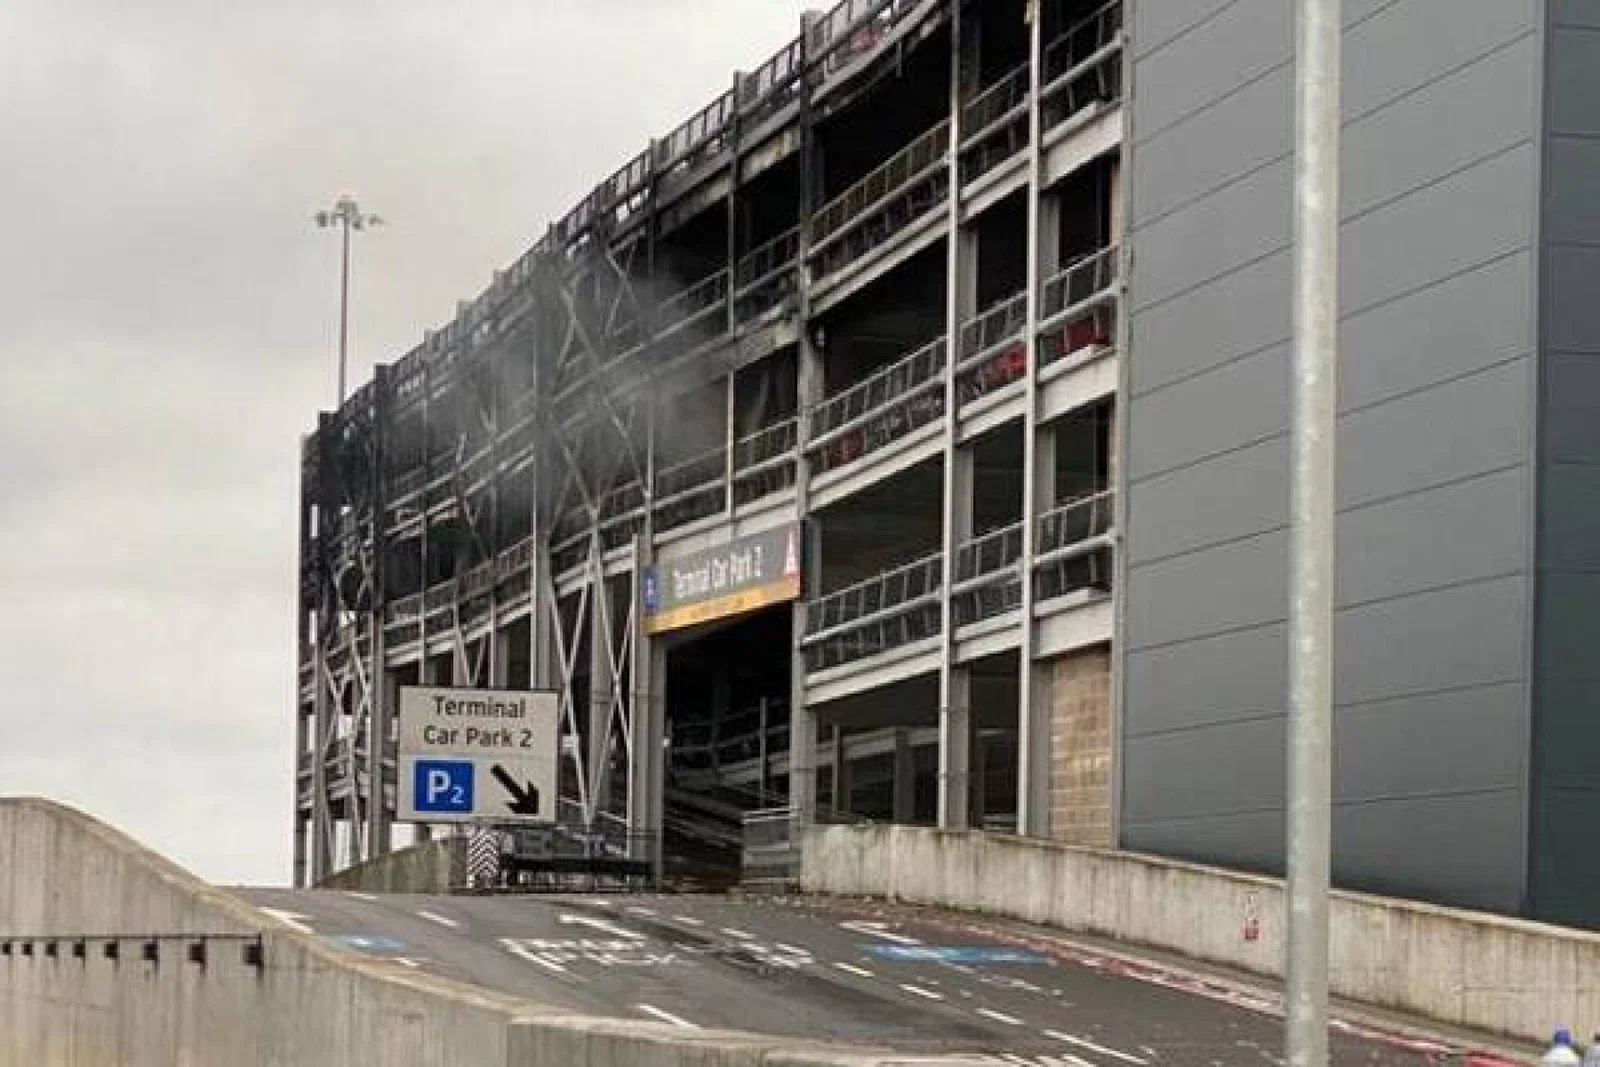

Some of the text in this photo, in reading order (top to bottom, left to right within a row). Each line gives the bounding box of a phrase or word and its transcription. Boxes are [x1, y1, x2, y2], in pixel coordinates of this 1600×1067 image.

[433, 696, 526, 718] Terminal
[423, 725, 532, 748] Car Park 2
